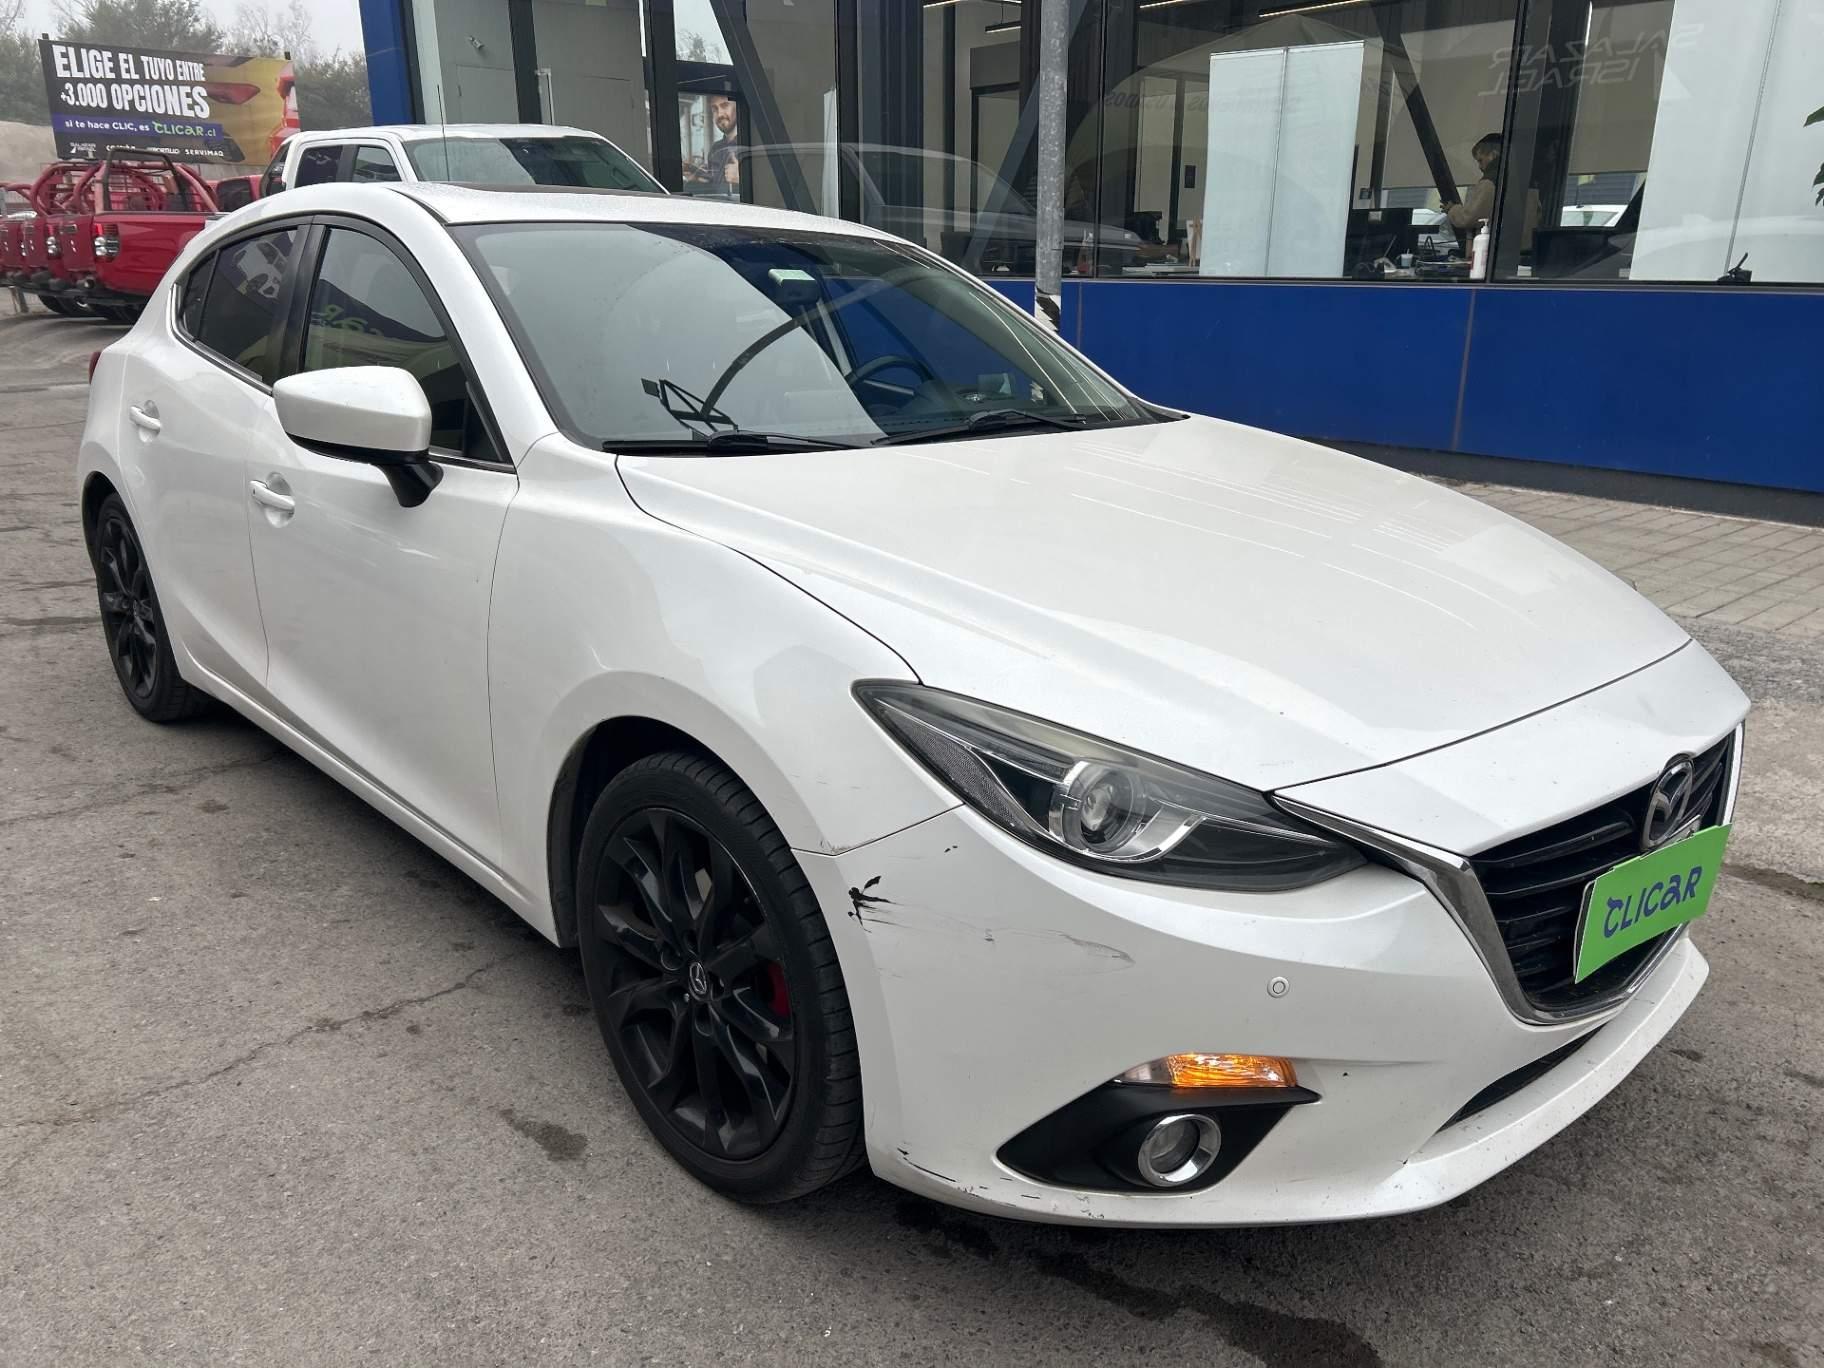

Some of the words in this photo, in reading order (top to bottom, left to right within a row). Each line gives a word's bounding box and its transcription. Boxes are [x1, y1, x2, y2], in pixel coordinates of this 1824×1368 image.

[52, 44, 116, 79] ELIGE
[118, 52, 140, 80] EL
[140, 55, 175, 81] TUYO
[175, 60, 206, 82] ENTRE
[60, 82, 109, 109] +3.000
[110, 83, 210, 119] OPCIONES
[65, 119, 73, 128] si
[75, 120, 86, 129] te
[87, 120, 110, 130] hace
[112, 122, 138, 132] CLIC,
[139, 124, 150, 132] es
